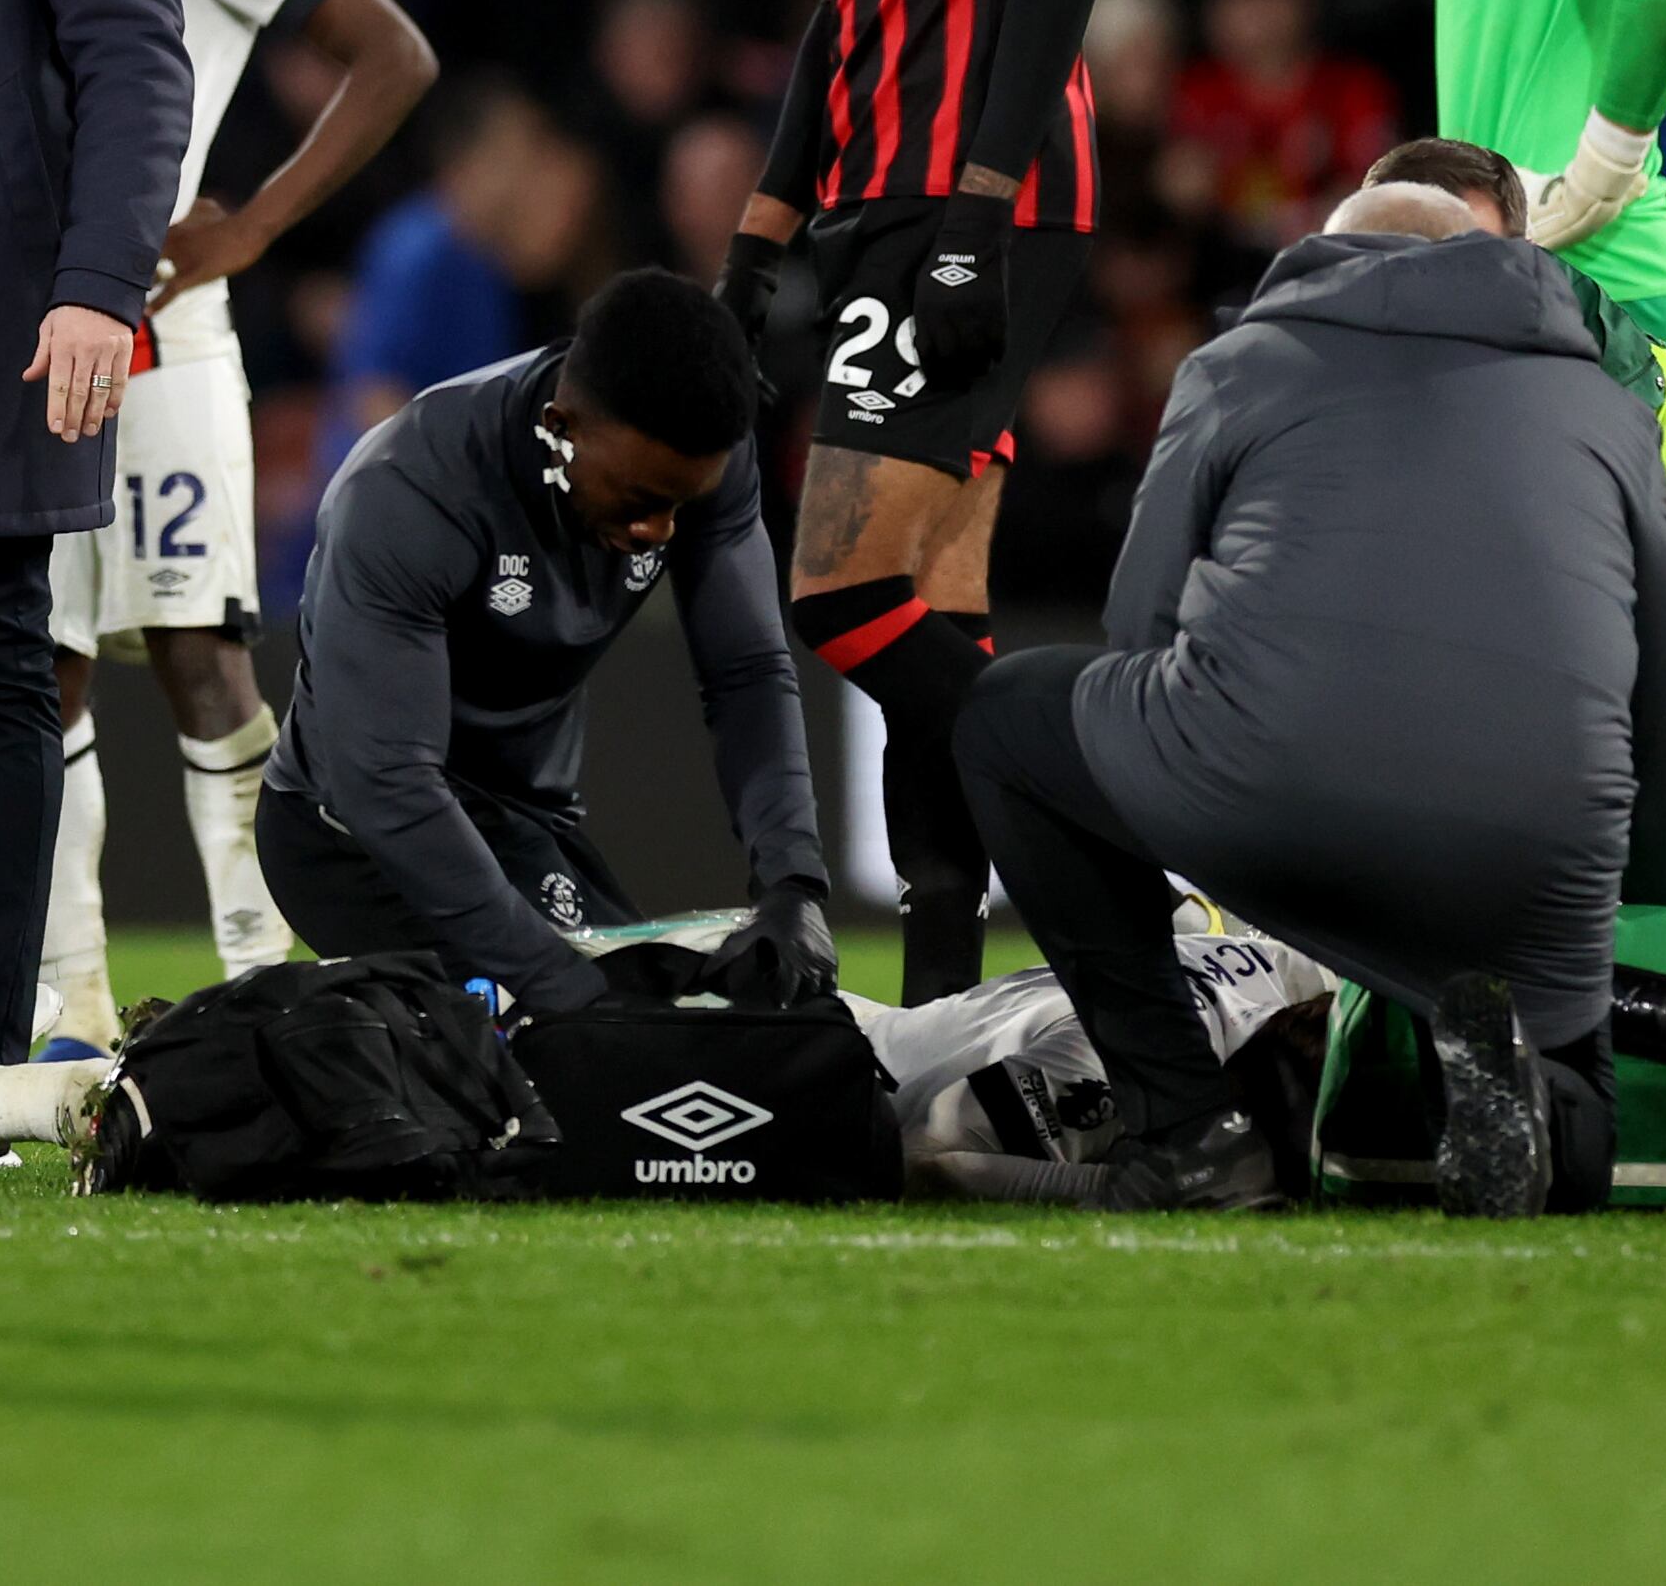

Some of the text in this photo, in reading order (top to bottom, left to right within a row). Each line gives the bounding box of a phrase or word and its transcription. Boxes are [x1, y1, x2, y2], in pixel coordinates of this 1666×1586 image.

[847, 409, 885, 425] umbro
[126, 471, 207, 561] 12
[498, 554, 530, 577] DOC
[635, 1153, 756, 1184] umbro
